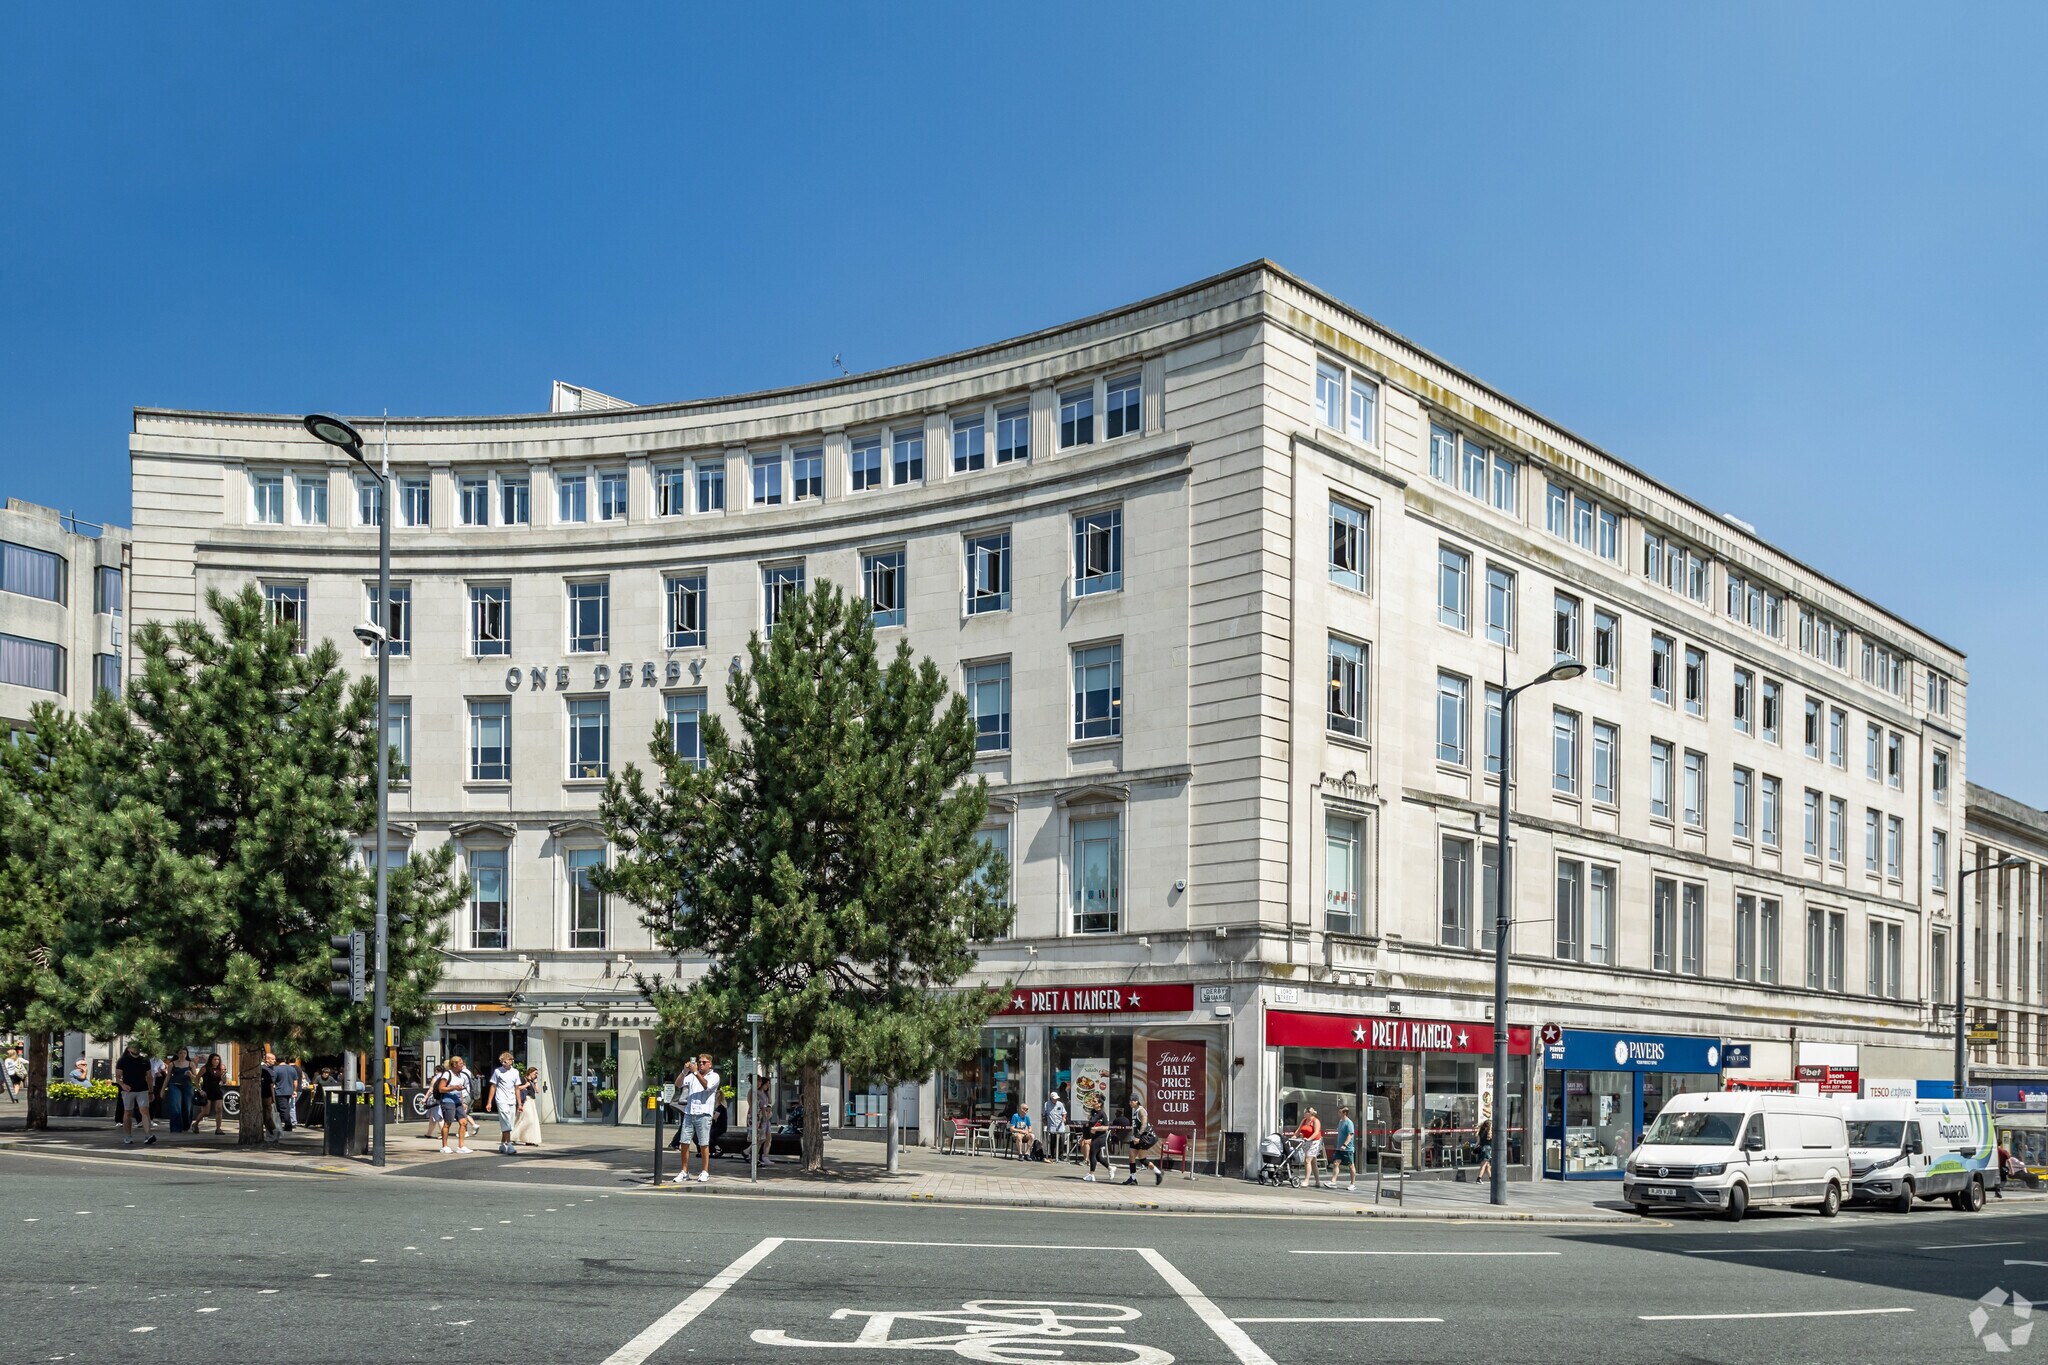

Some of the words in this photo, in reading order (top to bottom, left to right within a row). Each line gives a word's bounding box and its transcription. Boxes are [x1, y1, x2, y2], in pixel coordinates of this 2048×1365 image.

[506, 665, 570, 689] ONE
[594, 658, 707, 687] DERBY
[1031, 991, 1059, 1011] PRET
[1062, 991, 1070, 1010] A
[1074, 990, 1121, 1010] MANGER
[1371, 1020, 1398, 1047] PRET
[1401, 1022, 1408, 1047] A
[1412, 1023, 1452, 1049] MANGER
[1629, 1042, 1664, 1060] PAVERS
[1156, 1052, 1180, 1066] Join
[1181, 1052, 1196, 1063] the
[1163, 1066, 1190, 1075] HALF
[1161, 1077, 1191, 1088] PRICE
[1157, 1089, 1195, 1100] COFFEE
[1870, 1087, 1890, 1097] TESCO
[1890, 1086, 1912, 1098] express
[1162, 1102, 1189, 1112] CLUB
[1938, 1121, 1969, 1143] Aquacool
